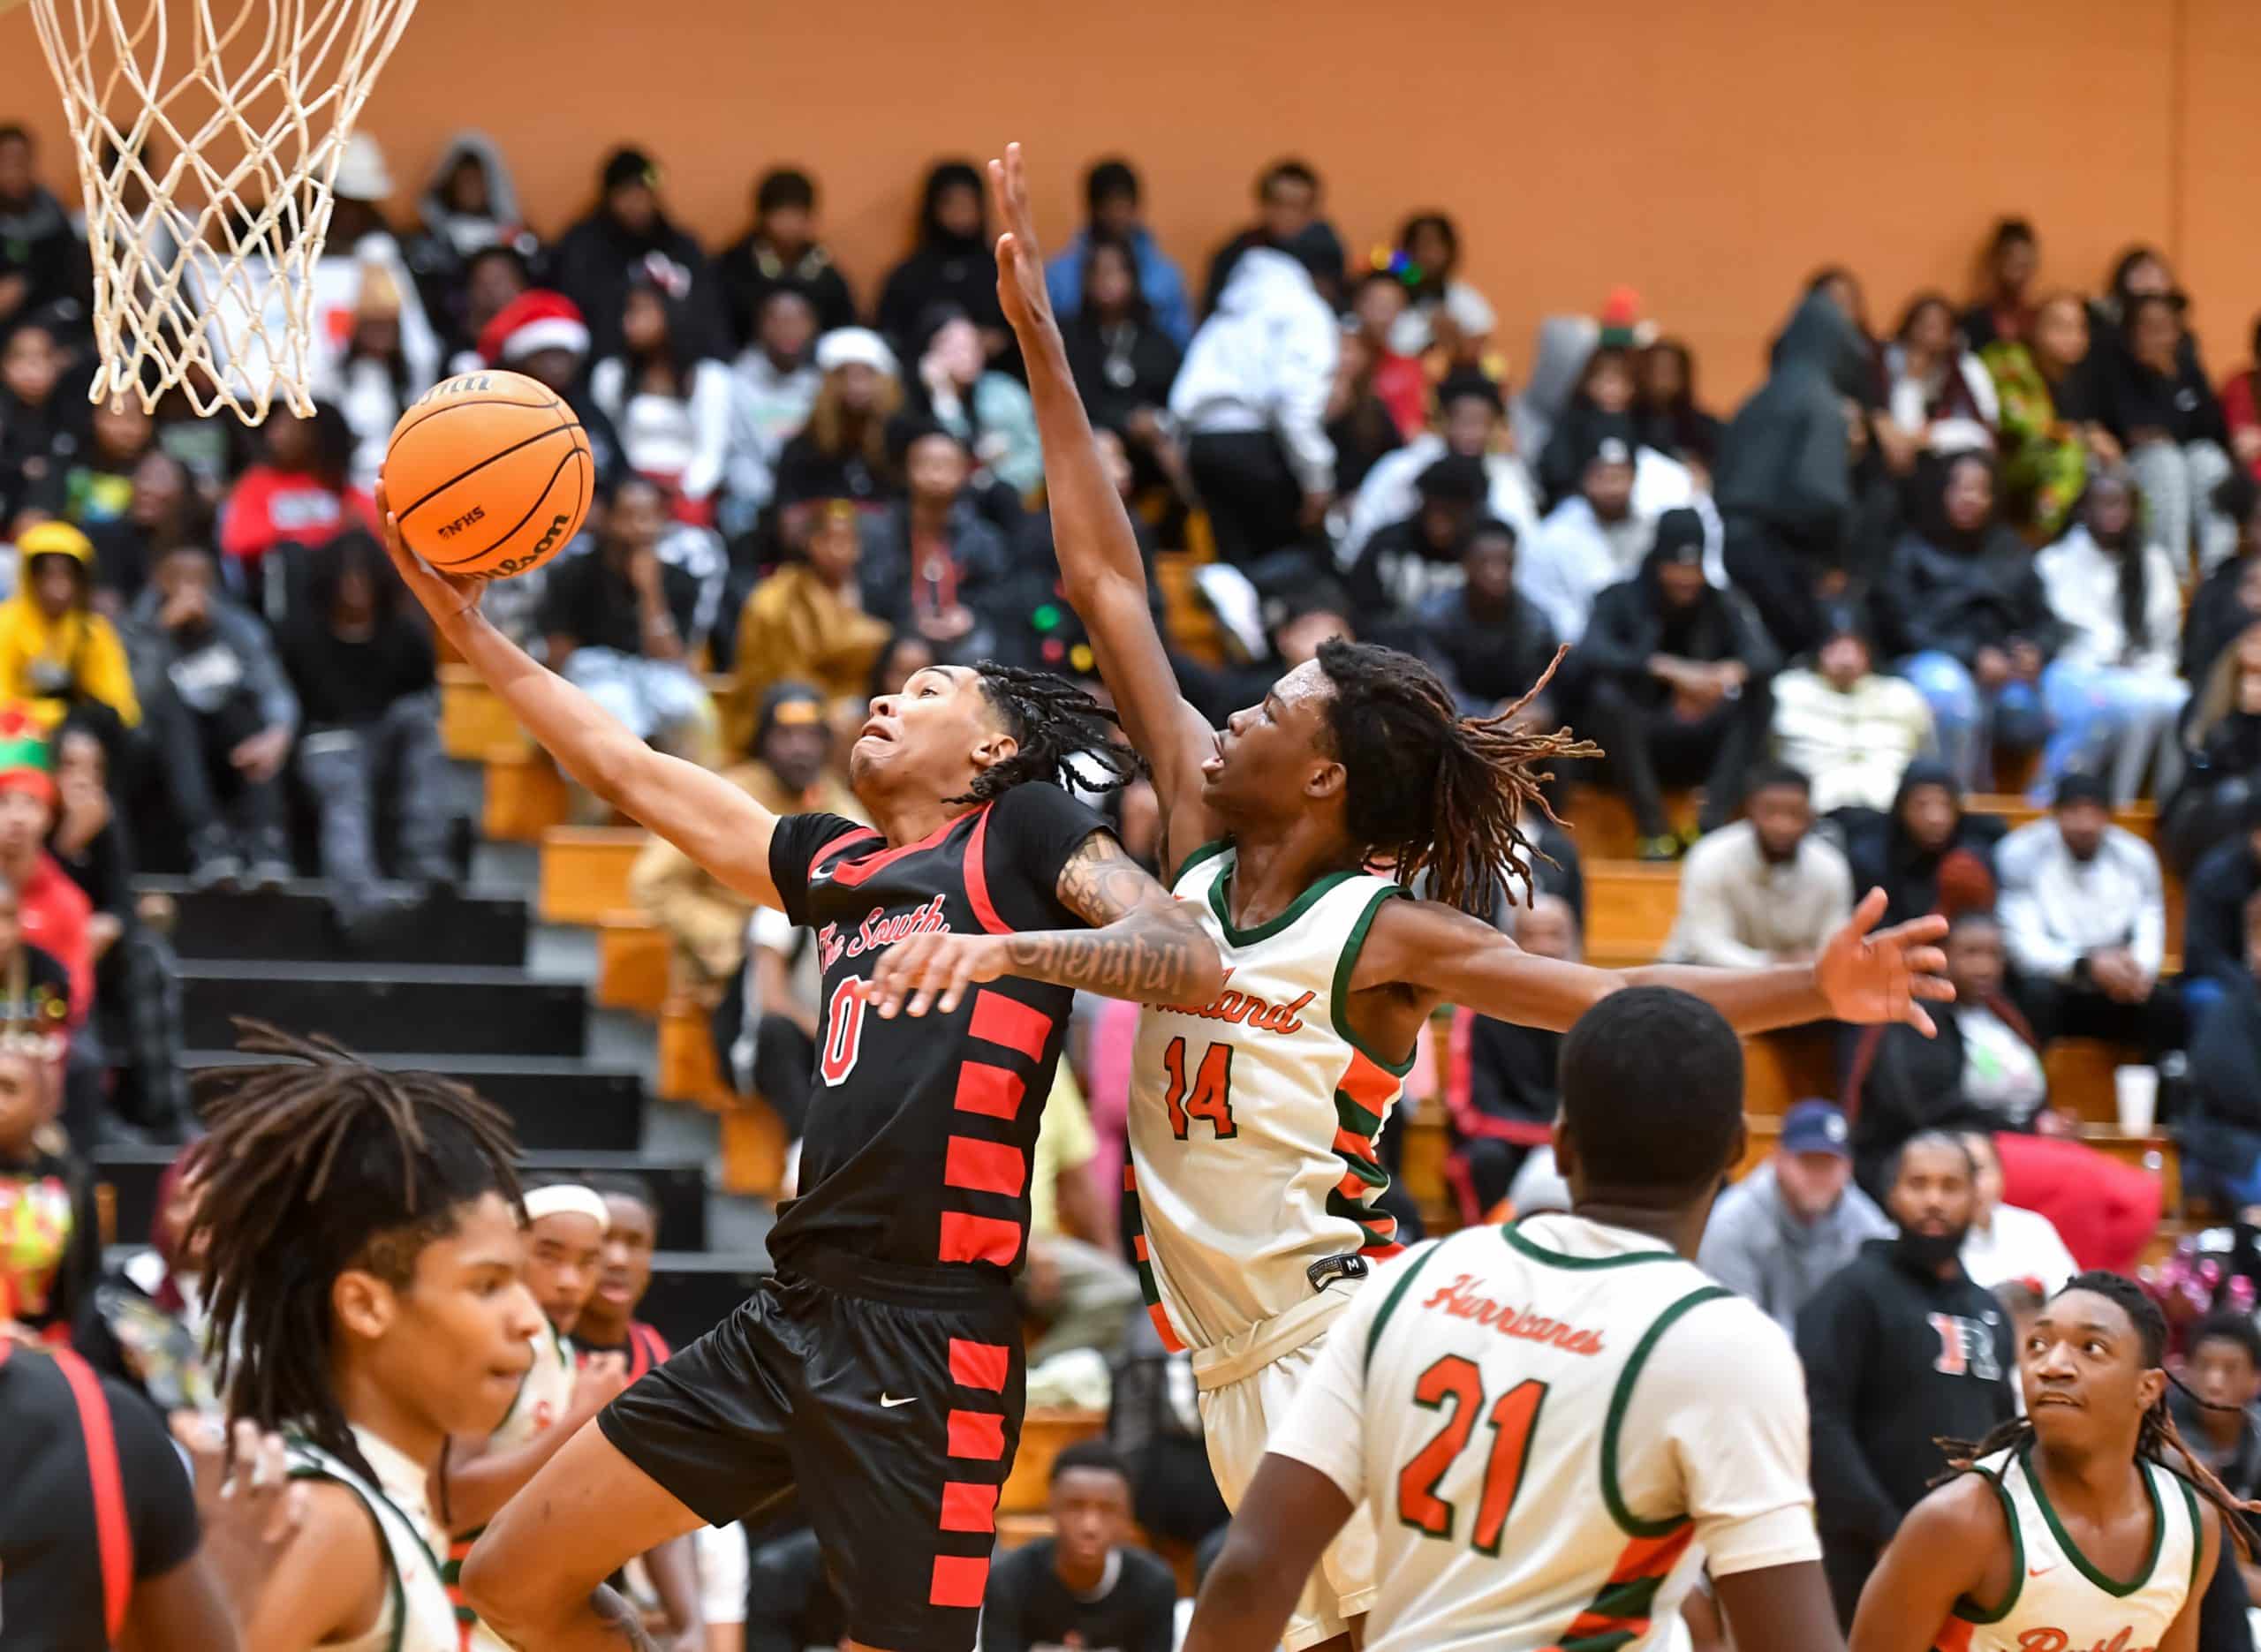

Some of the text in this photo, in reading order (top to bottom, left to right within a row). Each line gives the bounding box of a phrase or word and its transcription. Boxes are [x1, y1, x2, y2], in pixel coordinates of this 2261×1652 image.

[447, 506, 485, 536] NFHS
[846, 894, 950, 957] South
[820, 975, 866, 1087] 0
[1165, 1036, 1237, 1141] 14
[1346, 1258, 1359, 1271] M
[1423, 1274, 1606, 1355] Hurricanes
[1397, 1353, 1550, 1558] 21
